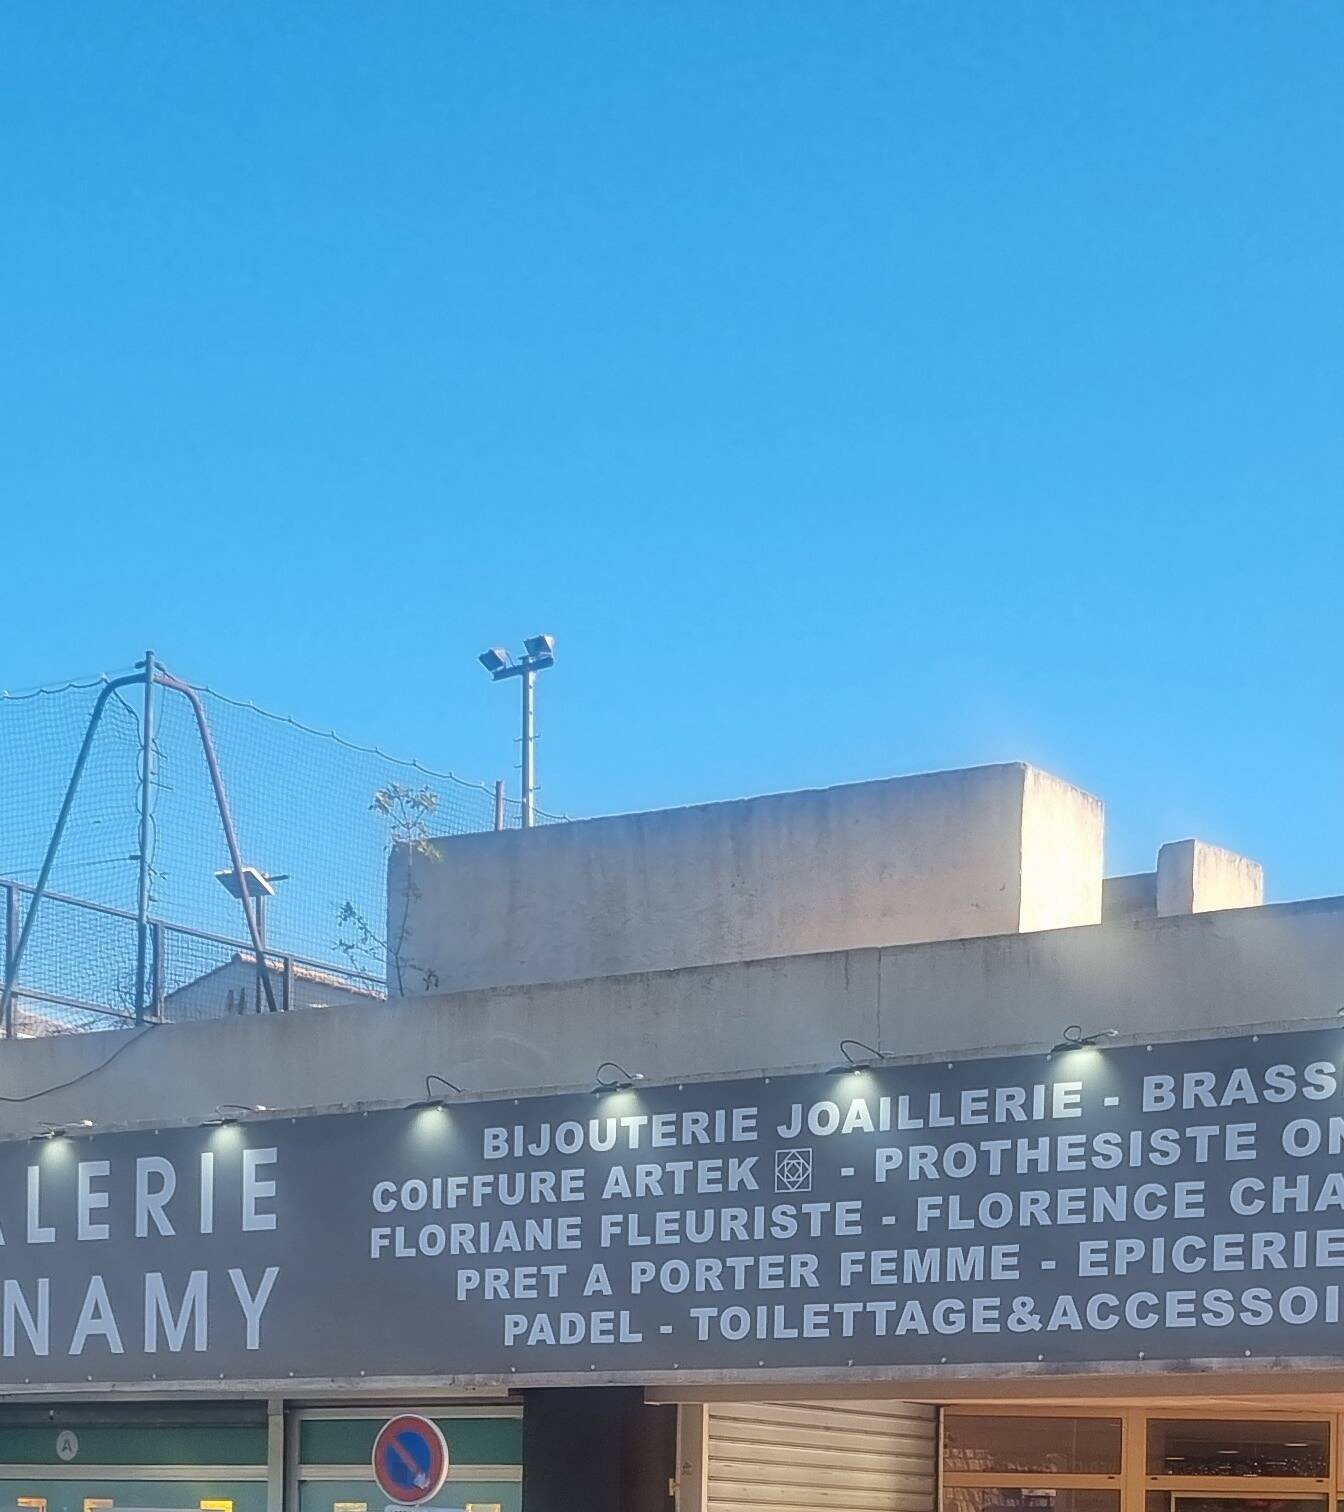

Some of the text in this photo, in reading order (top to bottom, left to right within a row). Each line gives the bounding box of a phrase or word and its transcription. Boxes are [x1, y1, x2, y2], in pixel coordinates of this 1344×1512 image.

[483, 1107, 758, 1159] BIJOUTERIE
[777, 1081, 1083, 1138] JOAILLERIE
[372, 1168, 585, 1213] COIFFURE
[601, 1157, 759, 1201] ARTEK
[875, 1122, 1257, 1182] PROTHESISTE
[371, 1217, 582, 1258] FLORIANE
[600, 1201, 862, 1248] FLEURISTE
[916, 1181, 1205, 1231] FLORENCE
[457, 1266, 567, 1301] PRET
[584, 1263, 612, 1296] A
[631, 1253, 819, 1294] PORTER
[840, 1244, 1021, 1287] FEMME
[504, 1310, 643, 1346] PADEL
